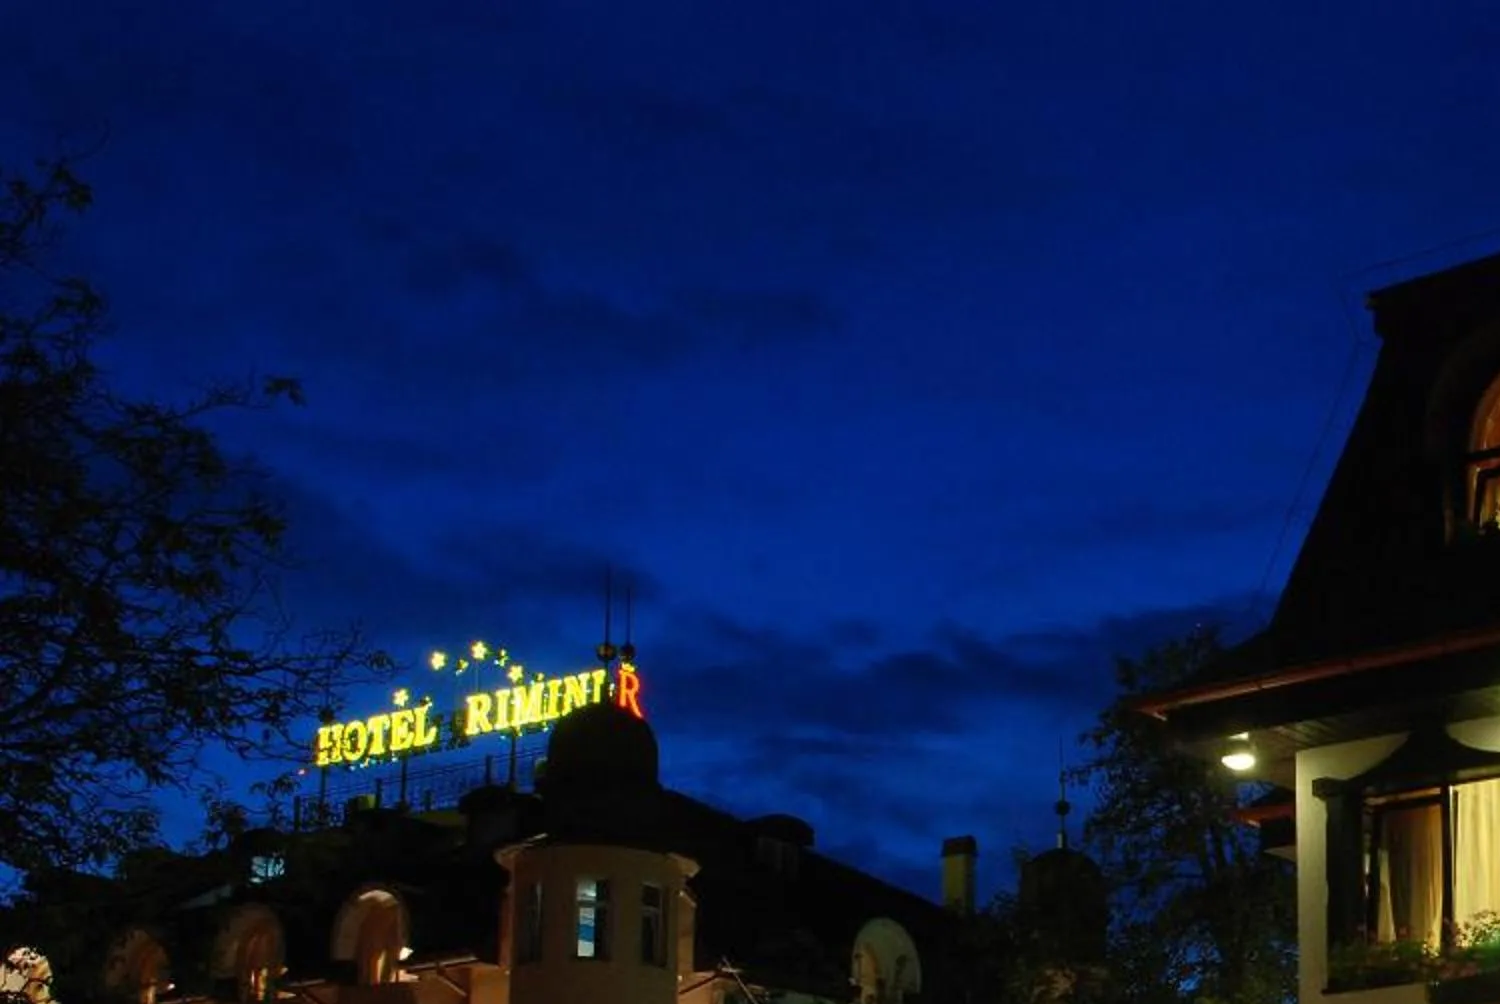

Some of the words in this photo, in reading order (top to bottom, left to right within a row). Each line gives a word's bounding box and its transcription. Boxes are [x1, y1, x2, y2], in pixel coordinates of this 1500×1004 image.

[316, 704, 437, 766] HOTEL
[465, 668, 605, 737] RIMINI
[618, 668, 644, 718] R
